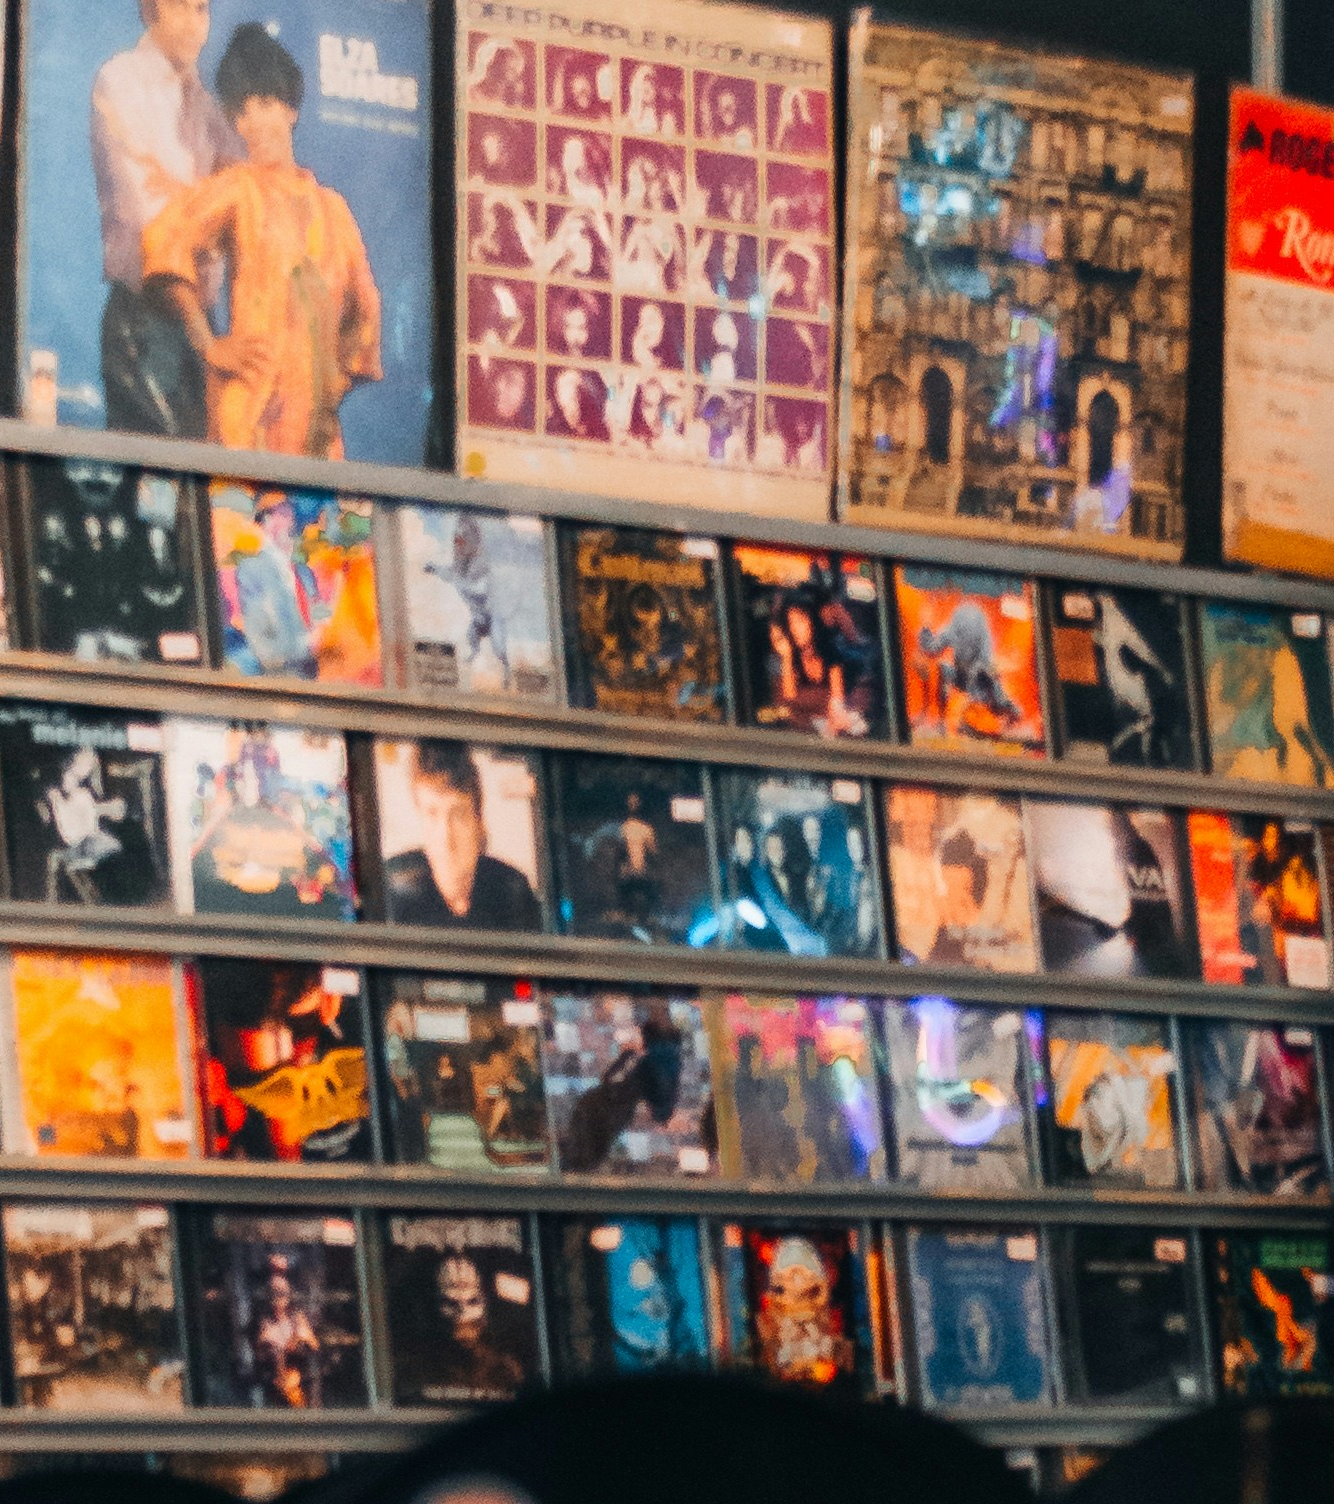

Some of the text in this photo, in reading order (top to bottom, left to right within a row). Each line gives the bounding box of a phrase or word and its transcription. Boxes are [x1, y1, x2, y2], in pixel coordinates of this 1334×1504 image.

[319, 32, 379, 72] ELZA
[548, 10, 657, 52] PURPLE
[664, 32, 691, 59] IN
[695, 36, 824, 81] CONCERT
